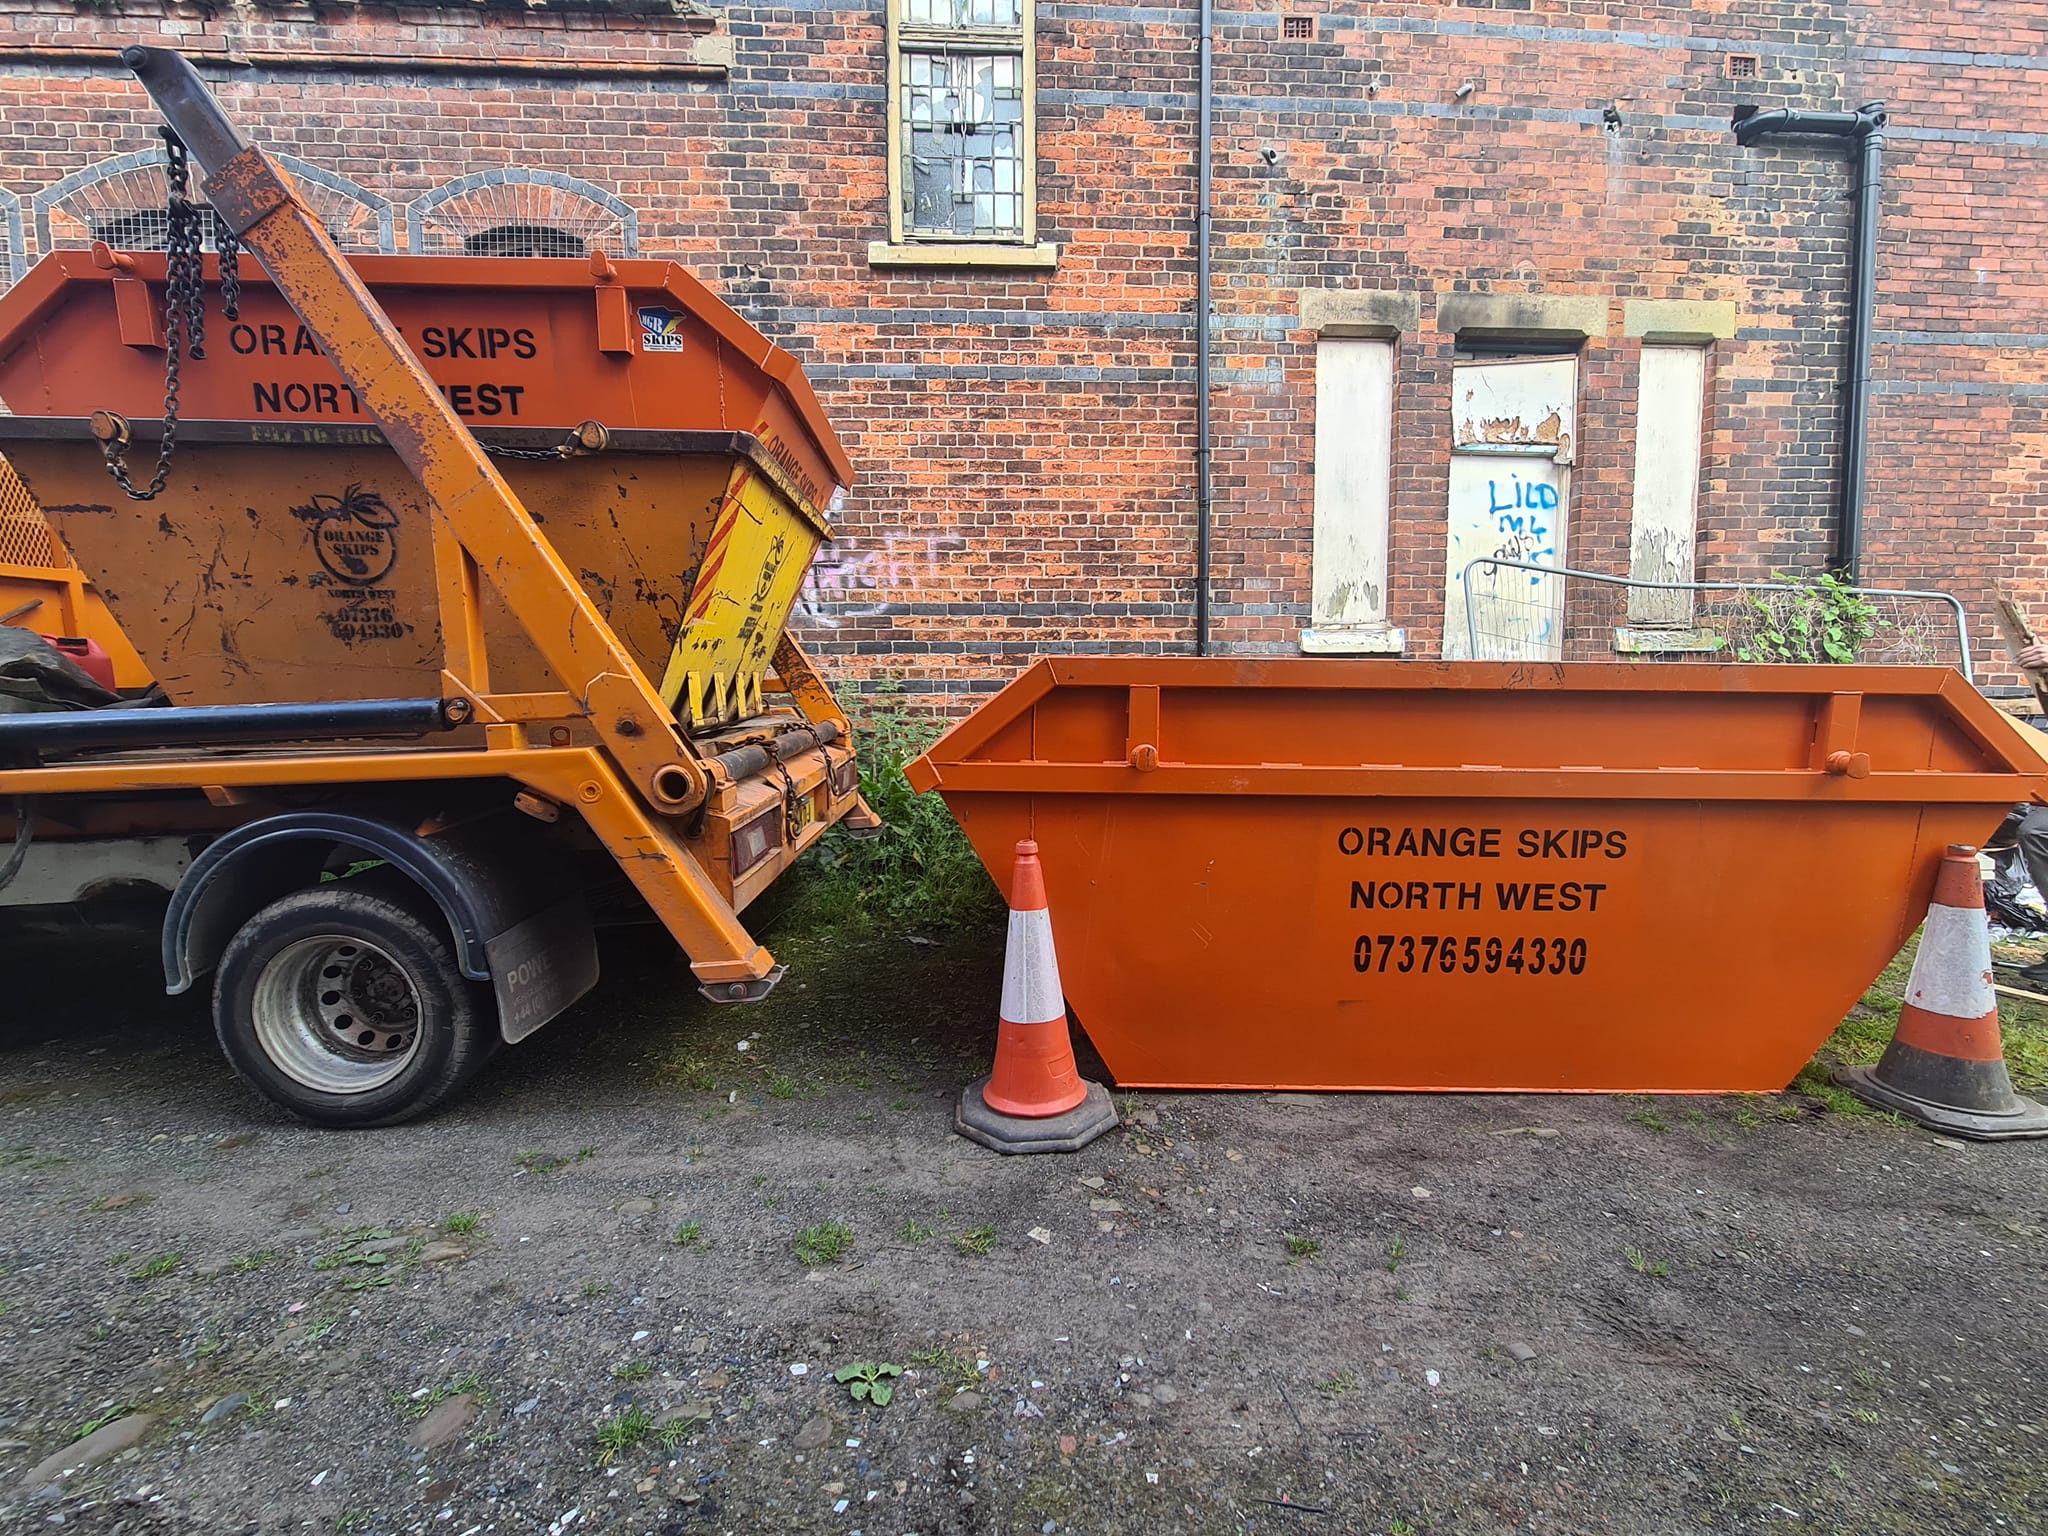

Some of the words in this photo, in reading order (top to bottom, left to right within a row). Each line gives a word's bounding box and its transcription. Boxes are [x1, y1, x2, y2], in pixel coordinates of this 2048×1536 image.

[421, 327, 537, 359] SKIPS
[643, 334, 683, 346] SKIPS
[252, 382, 365, 414] NORT
[768, 435, 803, 480] ORANGE
[324, 531, 385, 543] ORANGE
[333, 543, 380, 556] SKIPS
[368, 589, 397, 600] WEST
[1338, 827, 1502, 858] ORANGE
[1517, 829, 1627, 858] SKIPS
[1350, 881, 1481, 910] NORTH
[1496, 882, 1607, 912] WEST
[1354, 935, 1588, 975] 07376594330
